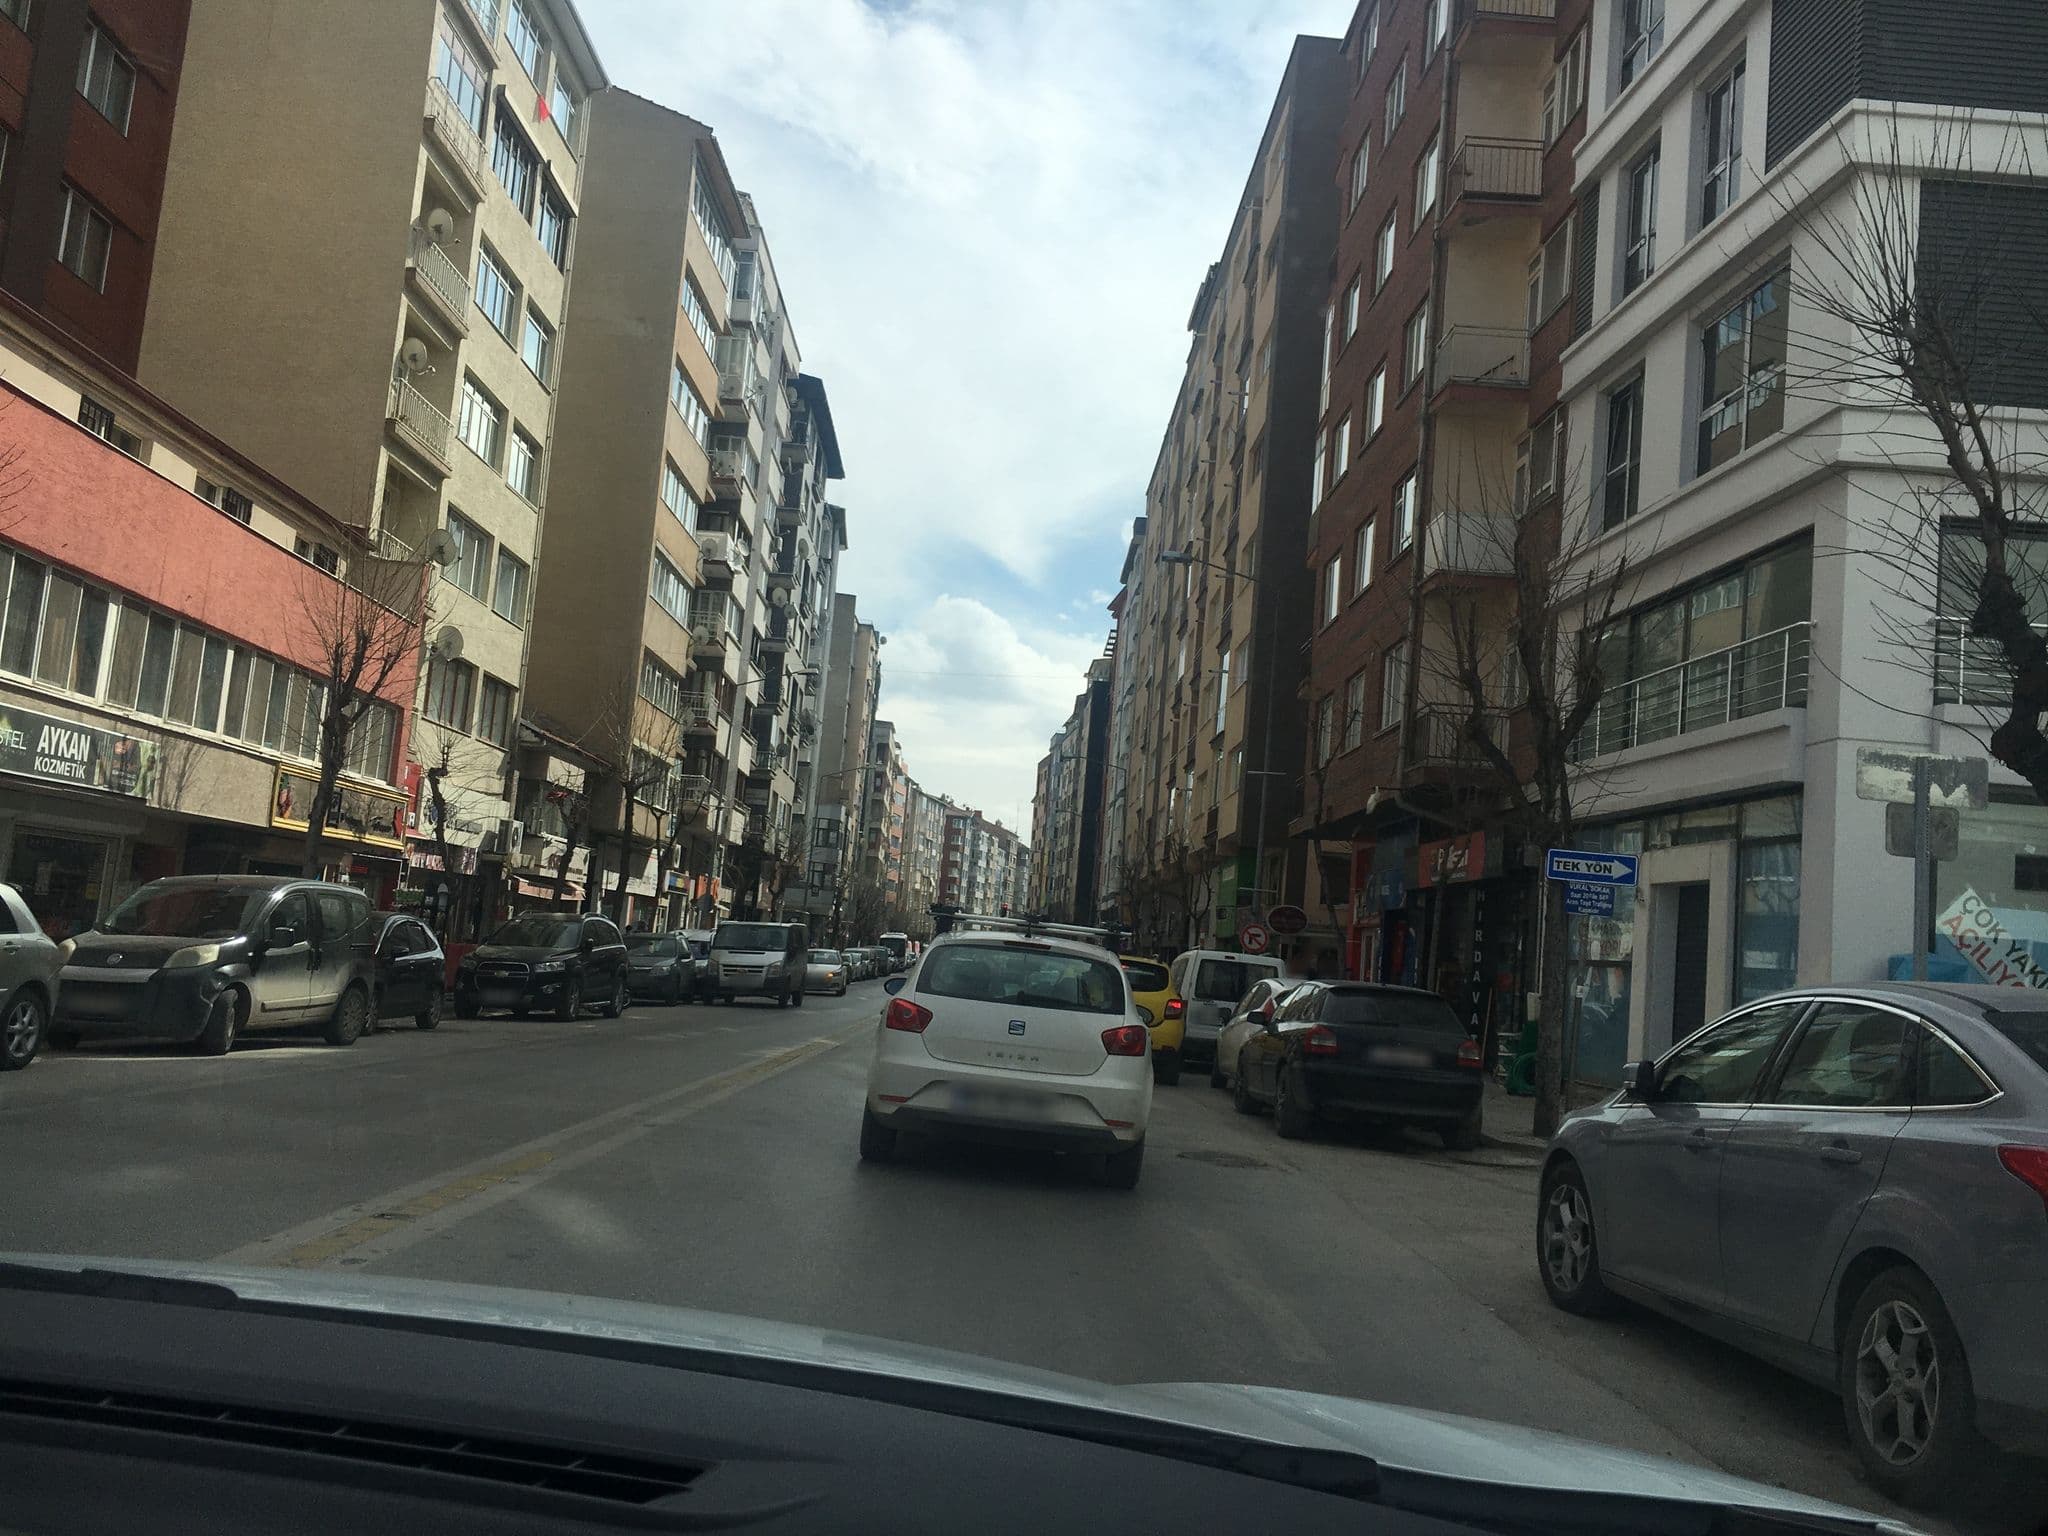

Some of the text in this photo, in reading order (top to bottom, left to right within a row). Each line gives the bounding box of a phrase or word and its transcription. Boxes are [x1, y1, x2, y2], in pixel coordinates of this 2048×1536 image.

[36, 725, 91, 762] AYKAN
[34, 756, 86, 779] KOZMETİK
[1555, 860, 1612, 874] TEK YÖN
[1960, 895, 2008, 944] ÇOK
